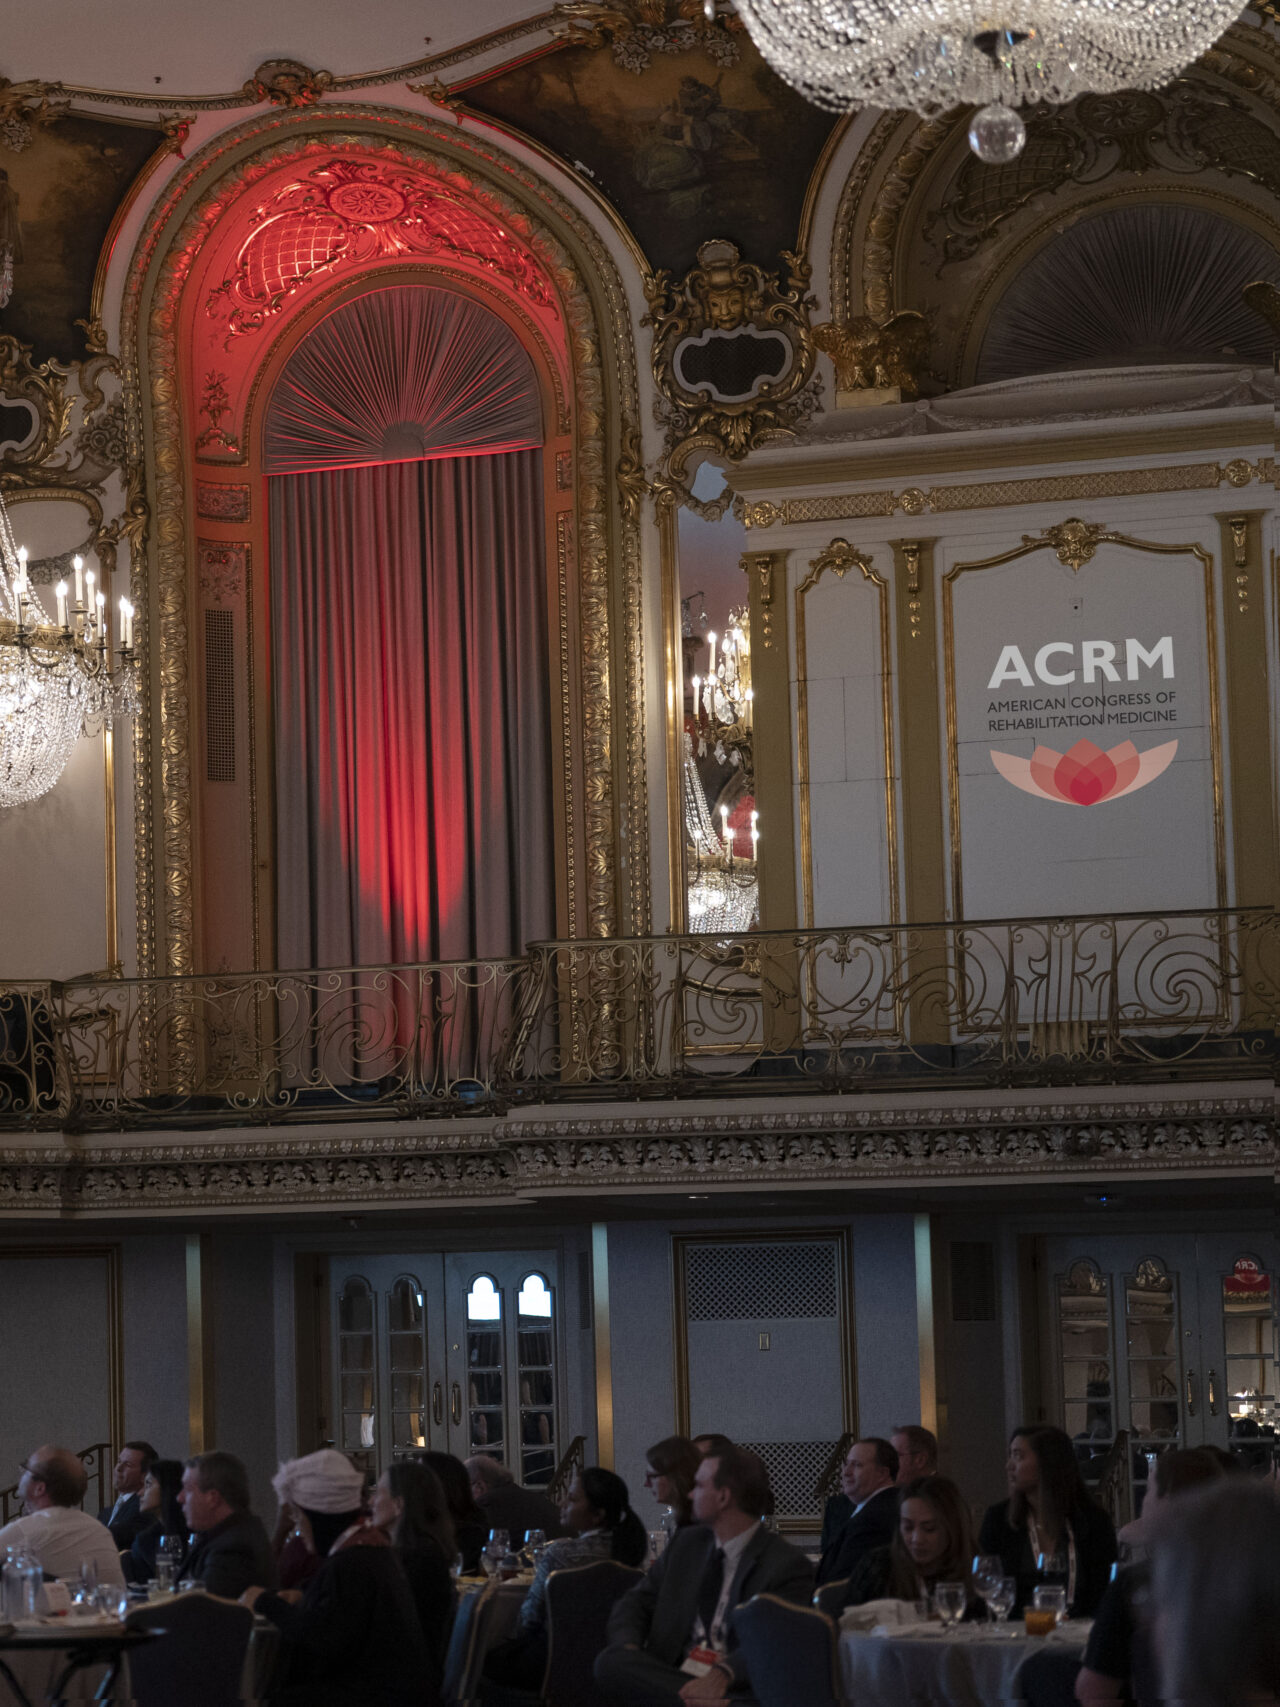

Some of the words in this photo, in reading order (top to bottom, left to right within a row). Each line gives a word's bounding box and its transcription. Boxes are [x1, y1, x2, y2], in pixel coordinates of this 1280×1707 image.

[987, 636, 1175, 689] ACRM
[987, 698, 1066, 713] AMERICAN
[1071, 693, 1151, 709] CONGRESS
[1156, 692, 1176, 704] OF
[988, 714, 1103, 732] REHABILITATION
[1107, 710, 1177, 725] MEDICINE
